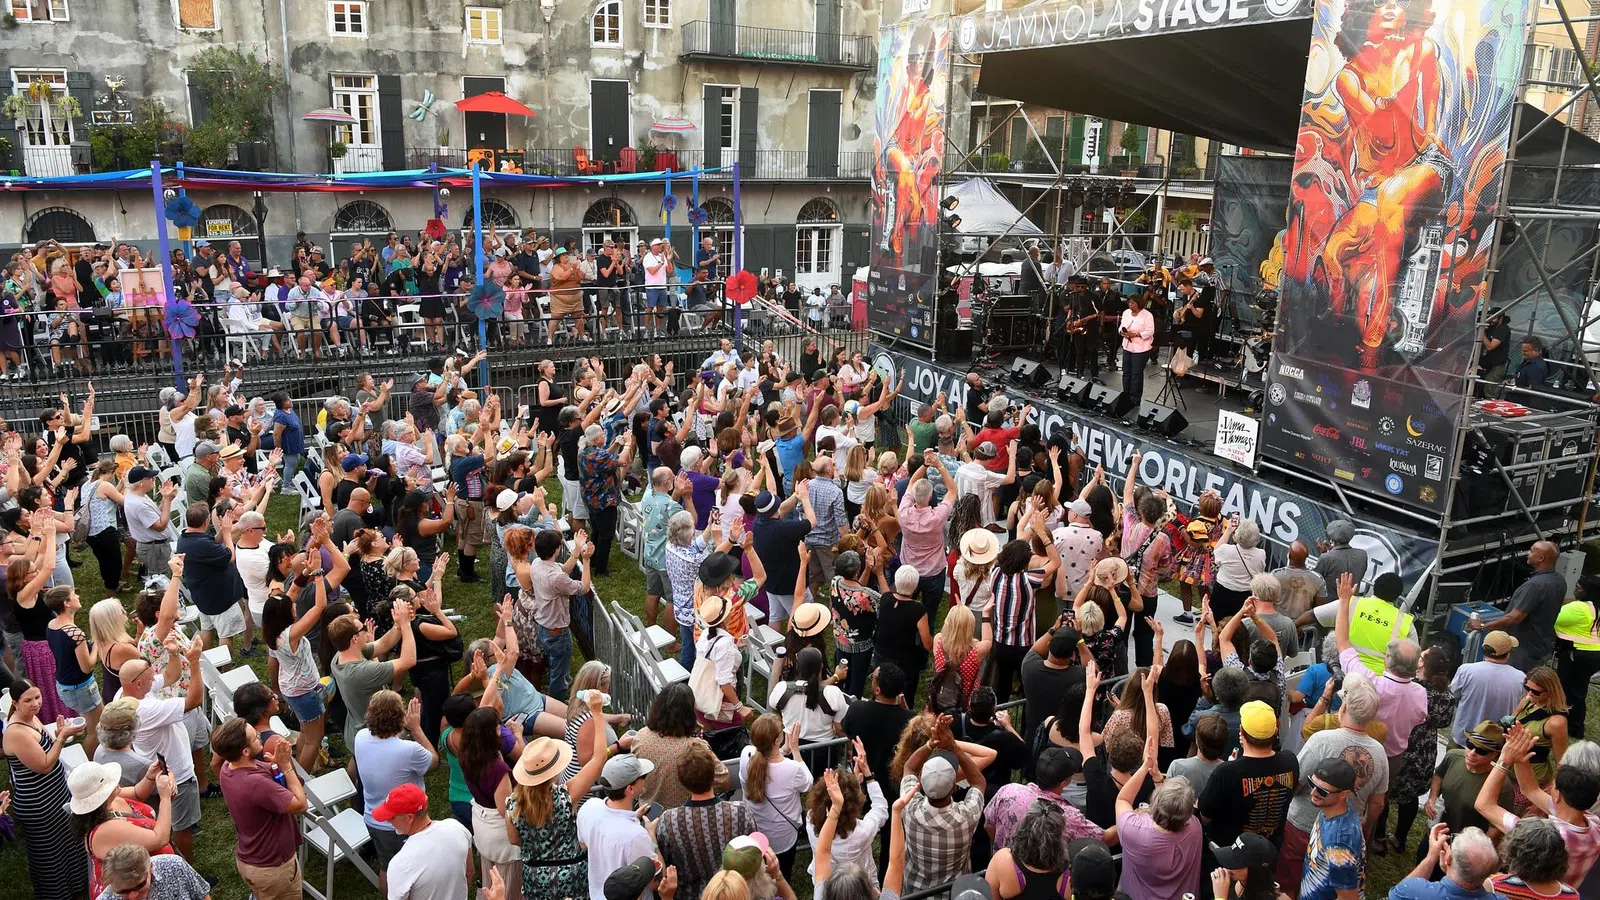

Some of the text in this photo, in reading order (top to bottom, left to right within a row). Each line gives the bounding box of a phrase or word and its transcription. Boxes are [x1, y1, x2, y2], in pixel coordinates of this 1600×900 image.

[983, 0, 1124, 49] JAMNOLA
[1133, 0, 1249, 31] STAGE
[908, 365, 946, 400] JOY
[1279, 364, 1304, 379] NOCCA
[1349, 435, 1367, 449] JBL
[1405, 437, 1447, 454] SAZERAC
[1070, 421, 1135, 474] NEW
[1139, 450, 1301, 543] ORLEANS
